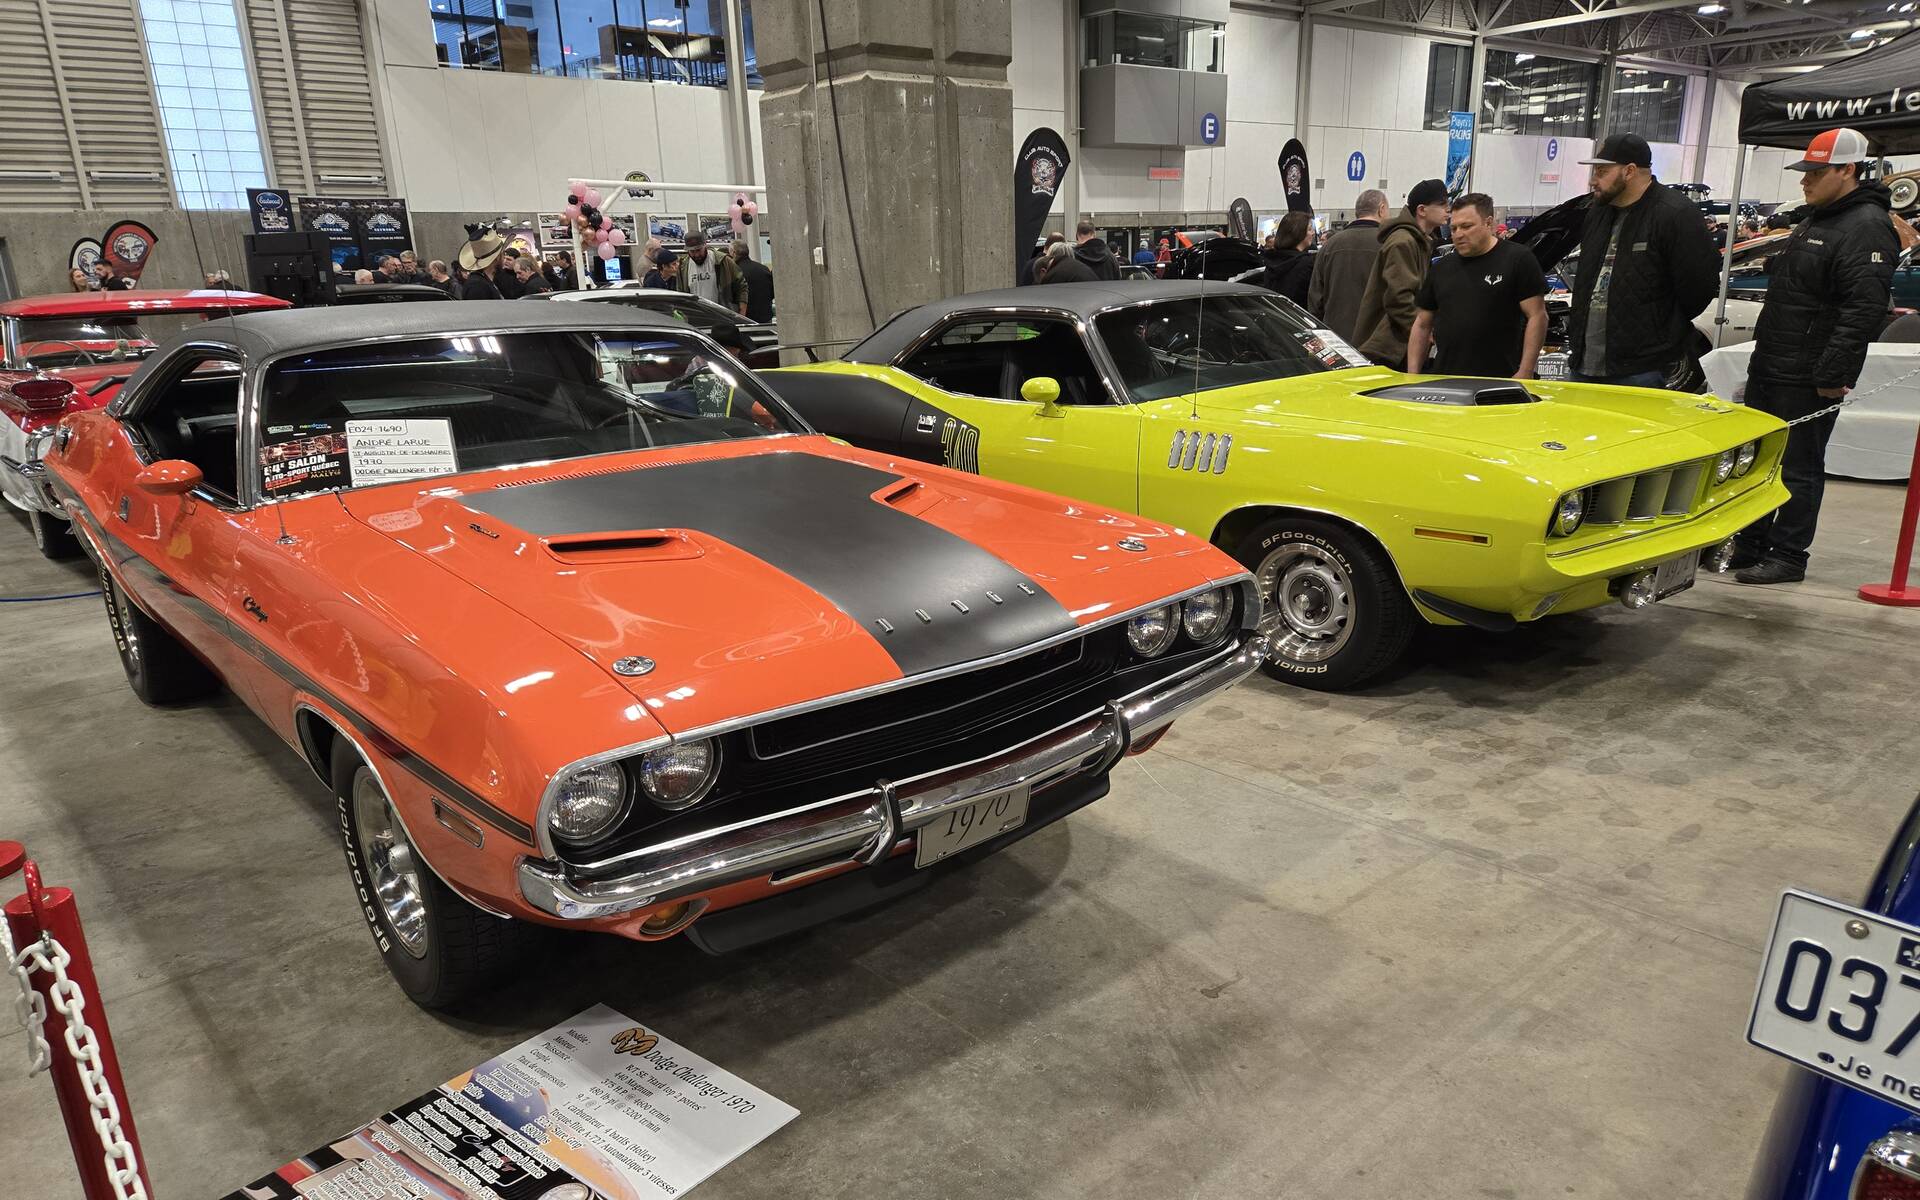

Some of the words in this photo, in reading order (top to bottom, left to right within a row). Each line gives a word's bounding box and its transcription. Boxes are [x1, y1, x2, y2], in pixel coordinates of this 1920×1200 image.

[1205, 118, 1214, 138] E
[1024, 148, 1036, 160] CLUB
[1050, 150, 1063, 168] SPORT
[1549, 142, 1556, 156] E
[691, 271, 711, 282] FILA
[1538, 365, 1558, 375] mach
[1559, 365, 1563, 375] 1
[288, 454, 326, 470] SALON
[312, 461, 340, 471] QUÉBEC
[1262, 531, 1353, 574] BFGoodrich
[876, 582, 1036, 634] DODGE
[1274, 660, 1328, 673] Radial
[338, 796, 391, 952] BFGoodrich
[1774, 940, 1920, 1057] 037
[541, 1042, 569, 1060] Puissance
[614, 1072, 628, 1080] 440
[625, 1078, 652, 1097] Magnum
[644, 1049, 676, 1071] Dodge
[672, 1064, 726, 1100] Challenger
[721, 1093, 756, 1114] 1970
[1838, 1056, 1872, 1080] Je
[1882, 1073, 1920, 1101] me
[574, 1093, 588, 1102] 9.7
[600, 1078, 616, 1088] 375
[632, 1098, 652, 1110] 4600
[663, 1086, 674, 1096] top
[588, 1086, 604, 1095] 480
[621, 1106, 641, 1120] 3200
[373, 1132, 394, 1147] Options
[424, 1129, 454, 1149] maximum
[521, 1124, 542, 1137] 3800
[538, 1134, 548, 1143] lbs
[567, 1105, 603, 1129] carburateur
[607, 1130, 629, 1146] barils
[624, 1142, 658, 1164] (Holley)
[493, 1140, 520, 1160] Ressorts
[523, 1161, 545, 1177] lames
[508, 1133, 527, 1147] Barres
[533, 1151, 558, 1169] torsion
[465, 1157, 482, 1168] 150
[580, 1130, 605, 1145] A-727
[601, 1142, 643, 1172] Automatique
[642, 1169, 649, 1177] 3
[649, 1173, 678, 1195] vitesses
